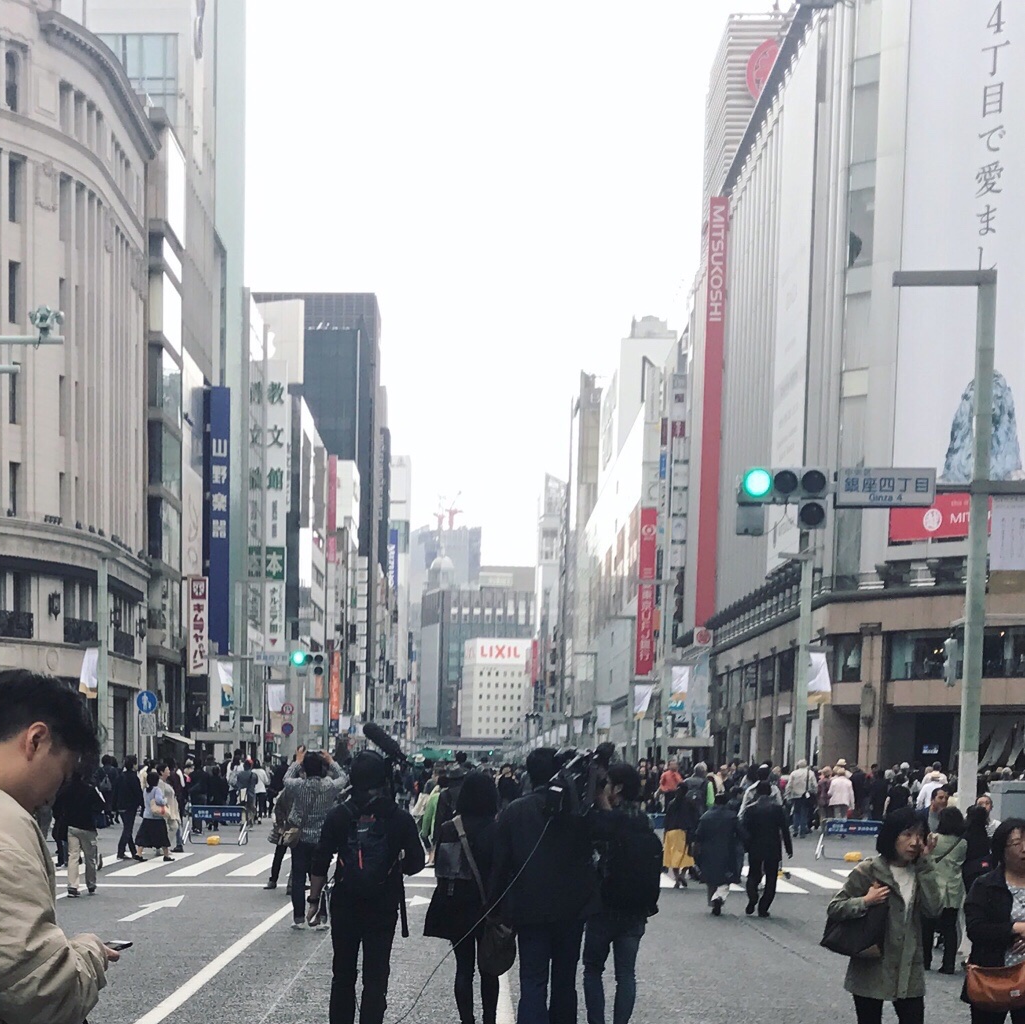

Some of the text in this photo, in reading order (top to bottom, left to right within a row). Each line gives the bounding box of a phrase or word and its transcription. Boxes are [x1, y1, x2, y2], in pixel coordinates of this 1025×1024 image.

[709, 205, 725, 322] MITSUKOSHI
[844, 477, 929, 493] 銀座四丁目
[869, 493, 903, 502] Ginza 4
[266, 551, 283, 576] 本
[193, 603, 206, 670] キムラヤのパン
[480, 645, 520, 659] LIXIL
